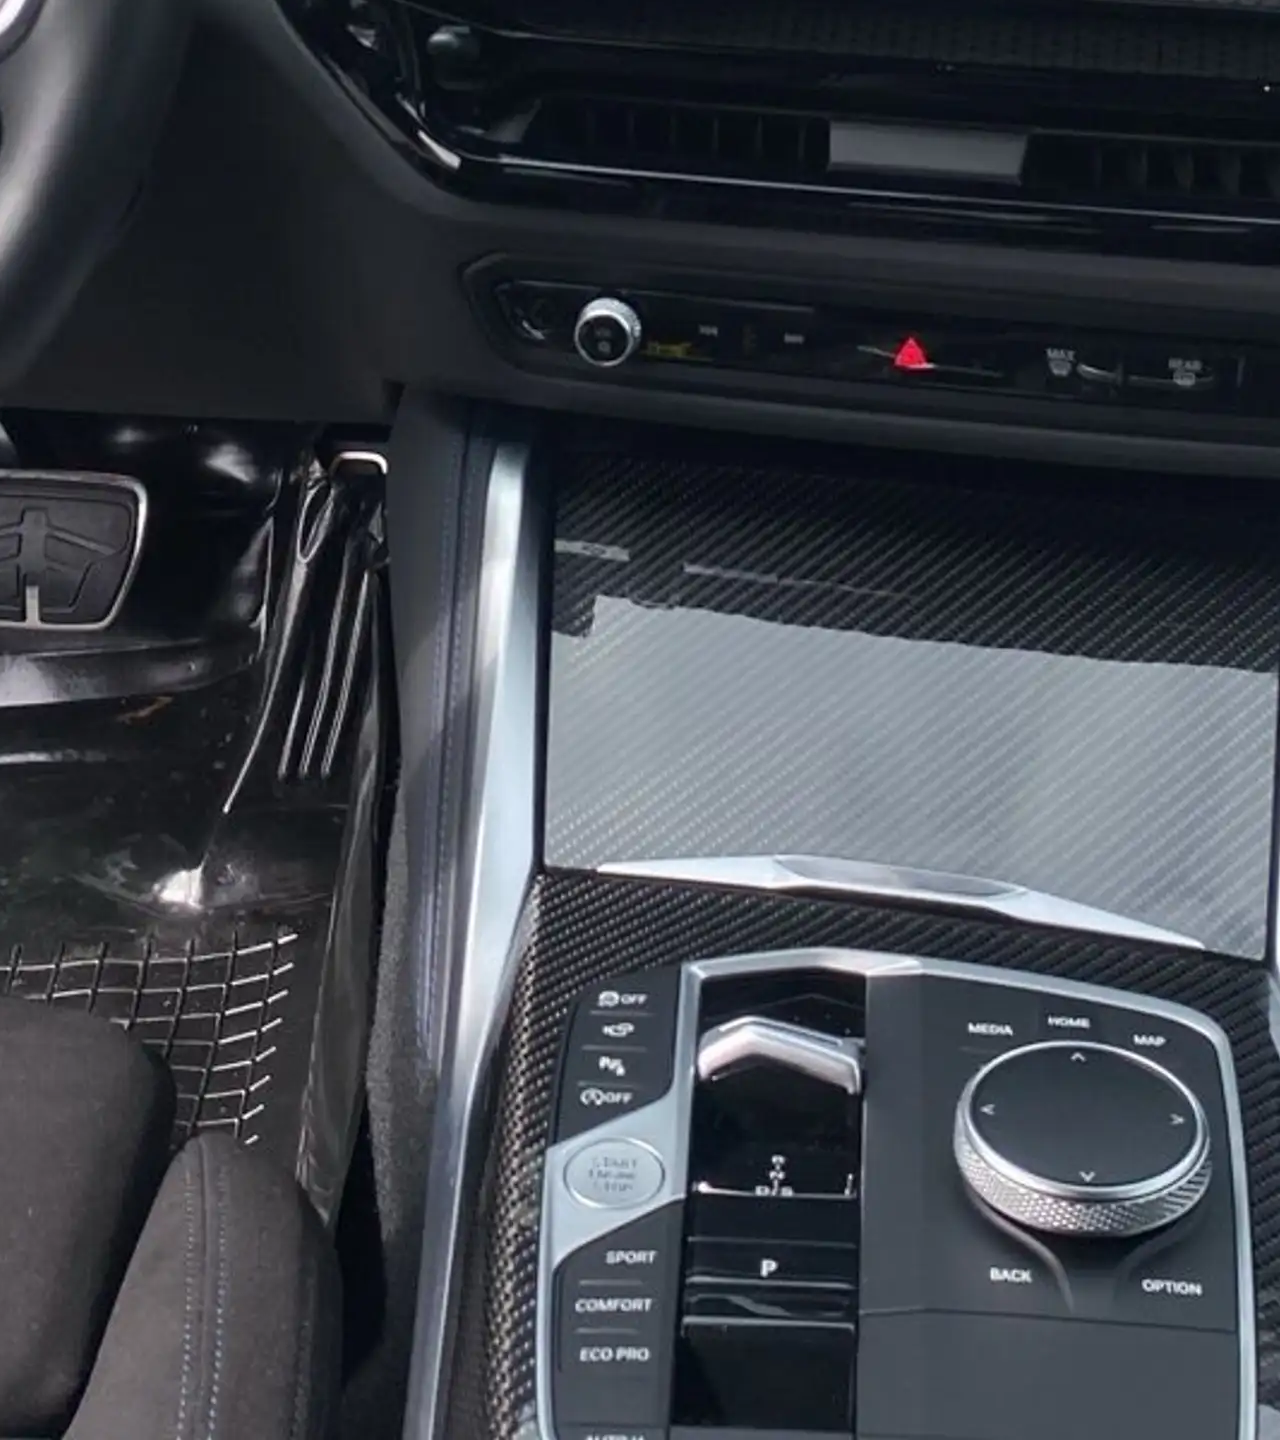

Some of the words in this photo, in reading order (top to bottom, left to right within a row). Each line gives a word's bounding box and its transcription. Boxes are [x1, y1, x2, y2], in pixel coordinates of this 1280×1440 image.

[621, 993, 648, 1005] OFF
[968, 1022, 1013, 1037] MEDIA
[1047, 1014, 1091, 1029] HOME
[1133, 1034, 1166, 1048] MAP
[603, 1091, 632, 1105] OFF
[606, 1249, 657, 1265] SPORT
[761, 1257, 779, 1278] P
[989, 1266, 1033, 1284] BACK
[1141, 1278, 1204, 1296] OPTION
[574, 1297, 653, 1313] COMFORT
[580, 1345, 614, 1362] ECO
[616, 1345, 651, 1362] PRO
